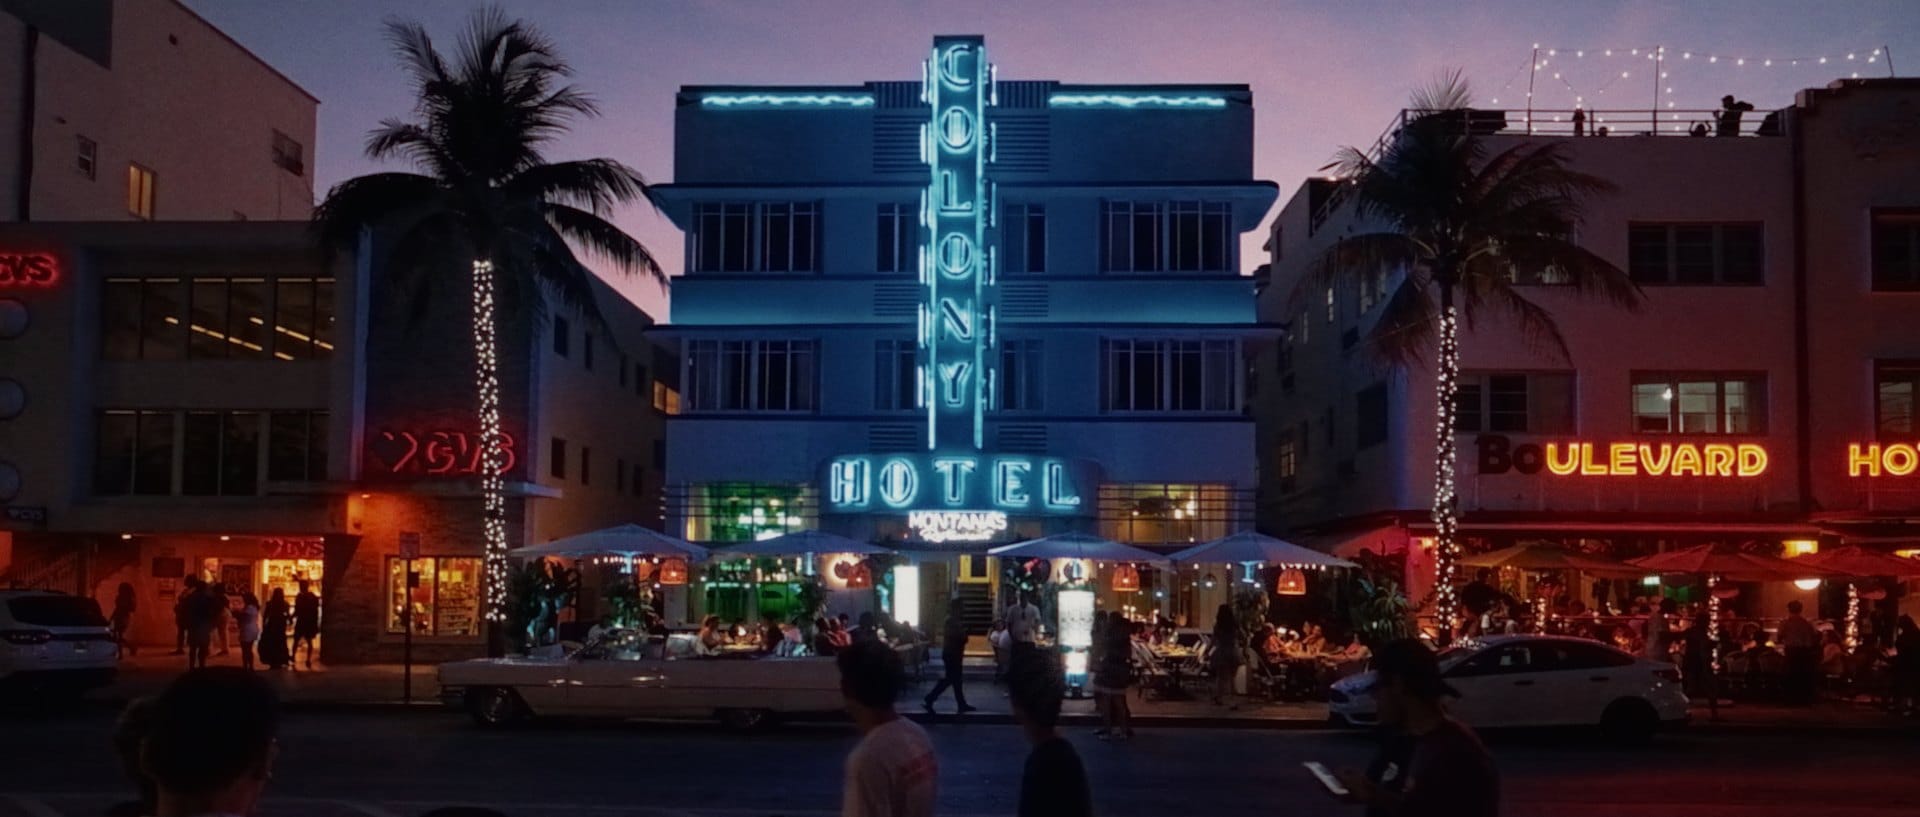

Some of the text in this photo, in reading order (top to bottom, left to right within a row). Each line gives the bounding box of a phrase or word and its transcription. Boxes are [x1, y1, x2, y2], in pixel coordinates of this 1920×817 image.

[937, 43, 976, 407] COLONY
[830, 458, 1081, 506] HOTEL
[1848, 442, 1920, 477] HO
